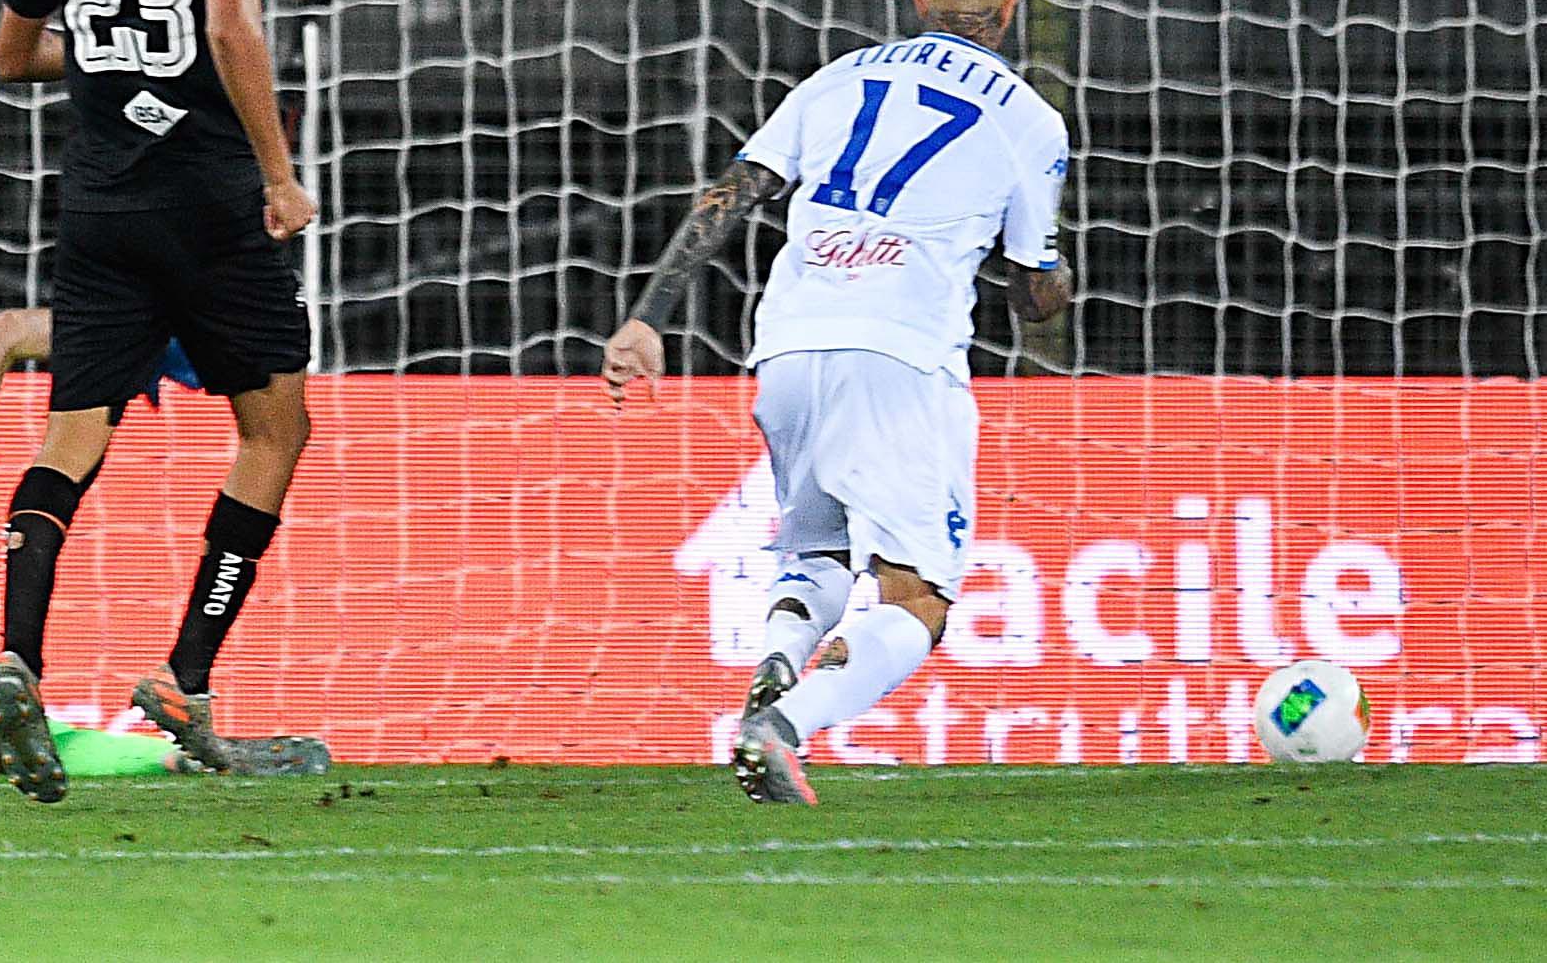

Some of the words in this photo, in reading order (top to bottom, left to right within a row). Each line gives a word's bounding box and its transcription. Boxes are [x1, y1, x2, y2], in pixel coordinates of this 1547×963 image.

[808, 78, 983, 217] 17
[803, 229, 912, 268] Giletti
[203, 551, 244, 616] ANATO
[941, 497, 1404, 668] acile
